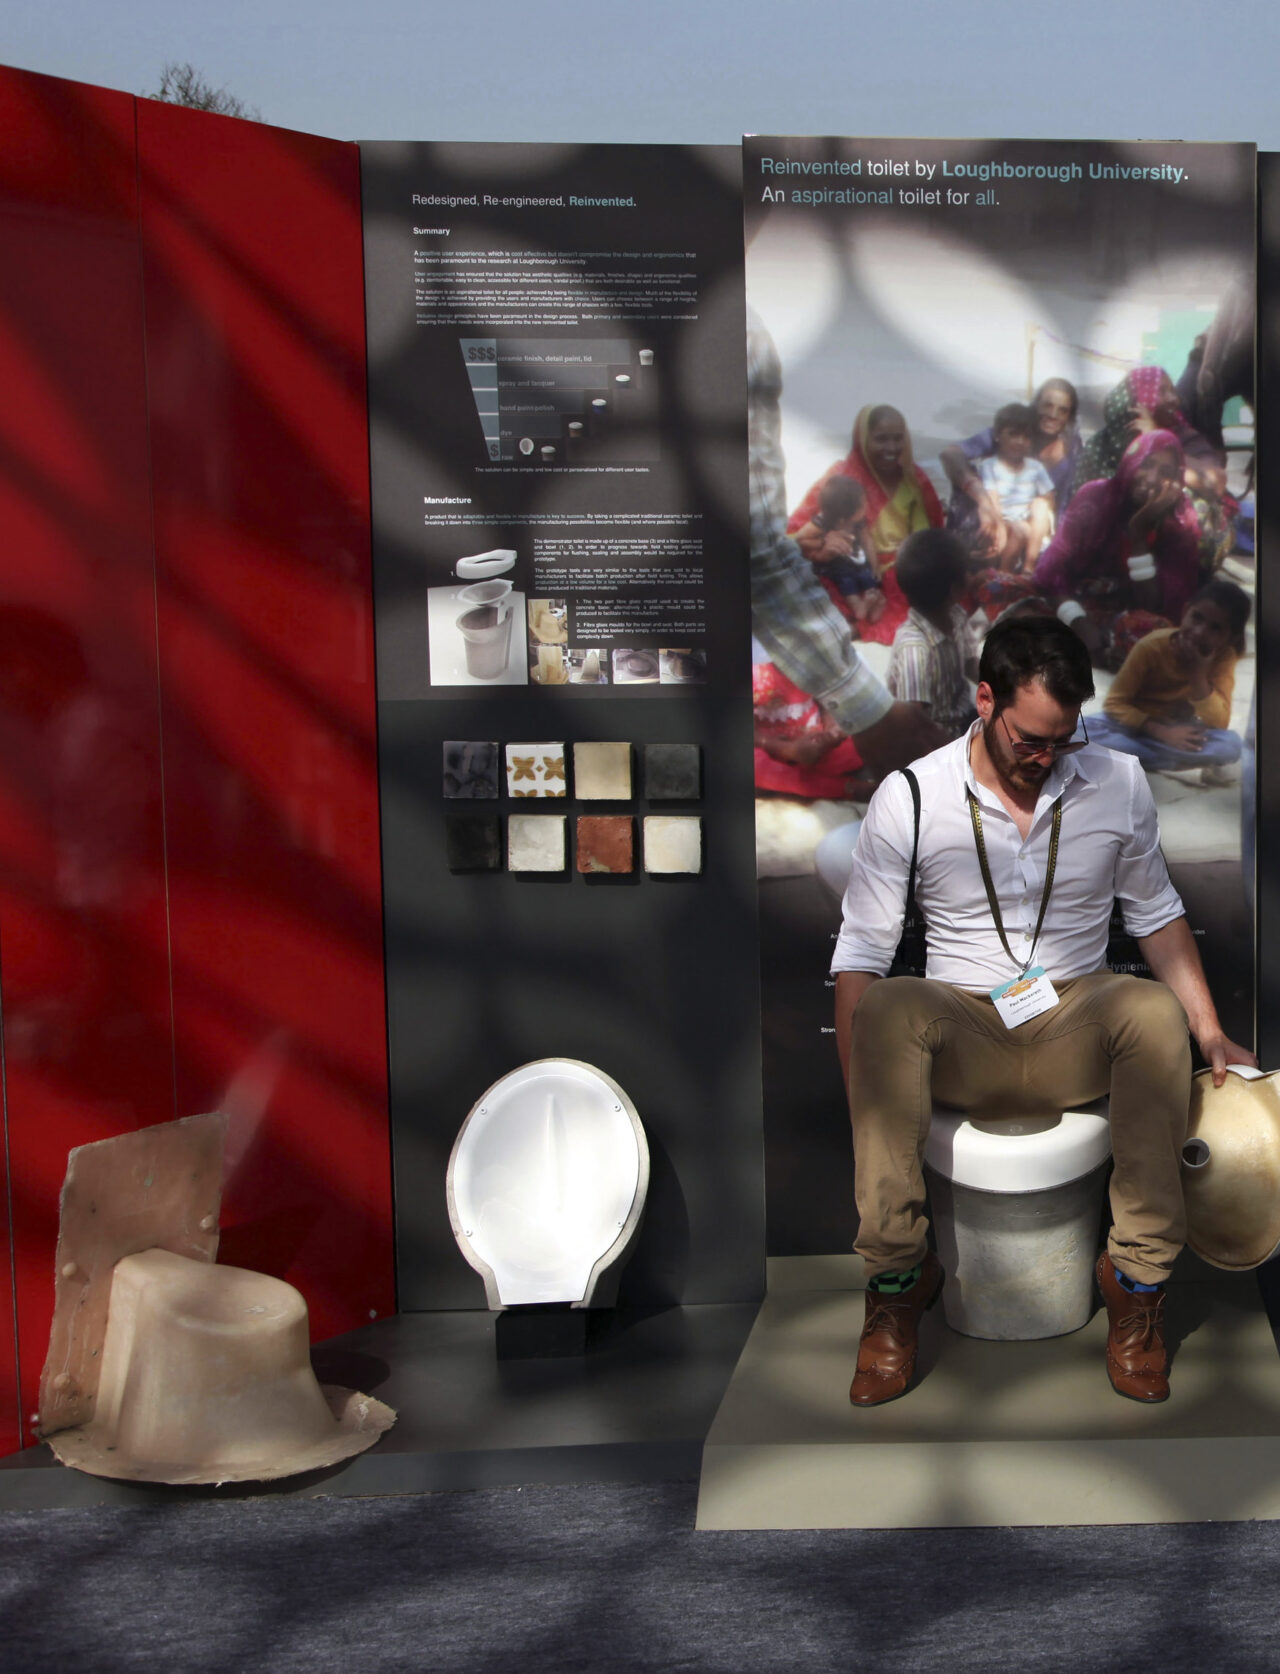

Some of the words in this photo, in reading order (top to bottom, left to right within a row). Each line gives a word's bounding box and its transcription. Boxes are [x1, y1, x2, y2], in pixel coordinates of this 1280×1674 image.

[761, 158, 862, 176] Reinvented
[867, 159, 910, 176] toilet
[915, 159, 936, 180] by
[942, 161, 1082, 182] Loughborough
[1089, 162, 1190, 184] University.
[412, 194, 480, 208] Redesigned,
[483, 195, 566, 208] Re-engineered,
[569, 196, 636, 207] Reinvented.
[761, 186, 785, 202] An
[791, 187, 893, 207] aspirational
[899, 188, 941, 204] toilet
[946, 188, 970, 205] for
[976, 189, 1000, 205] all.
[413, 227, 450, 236] Summary
